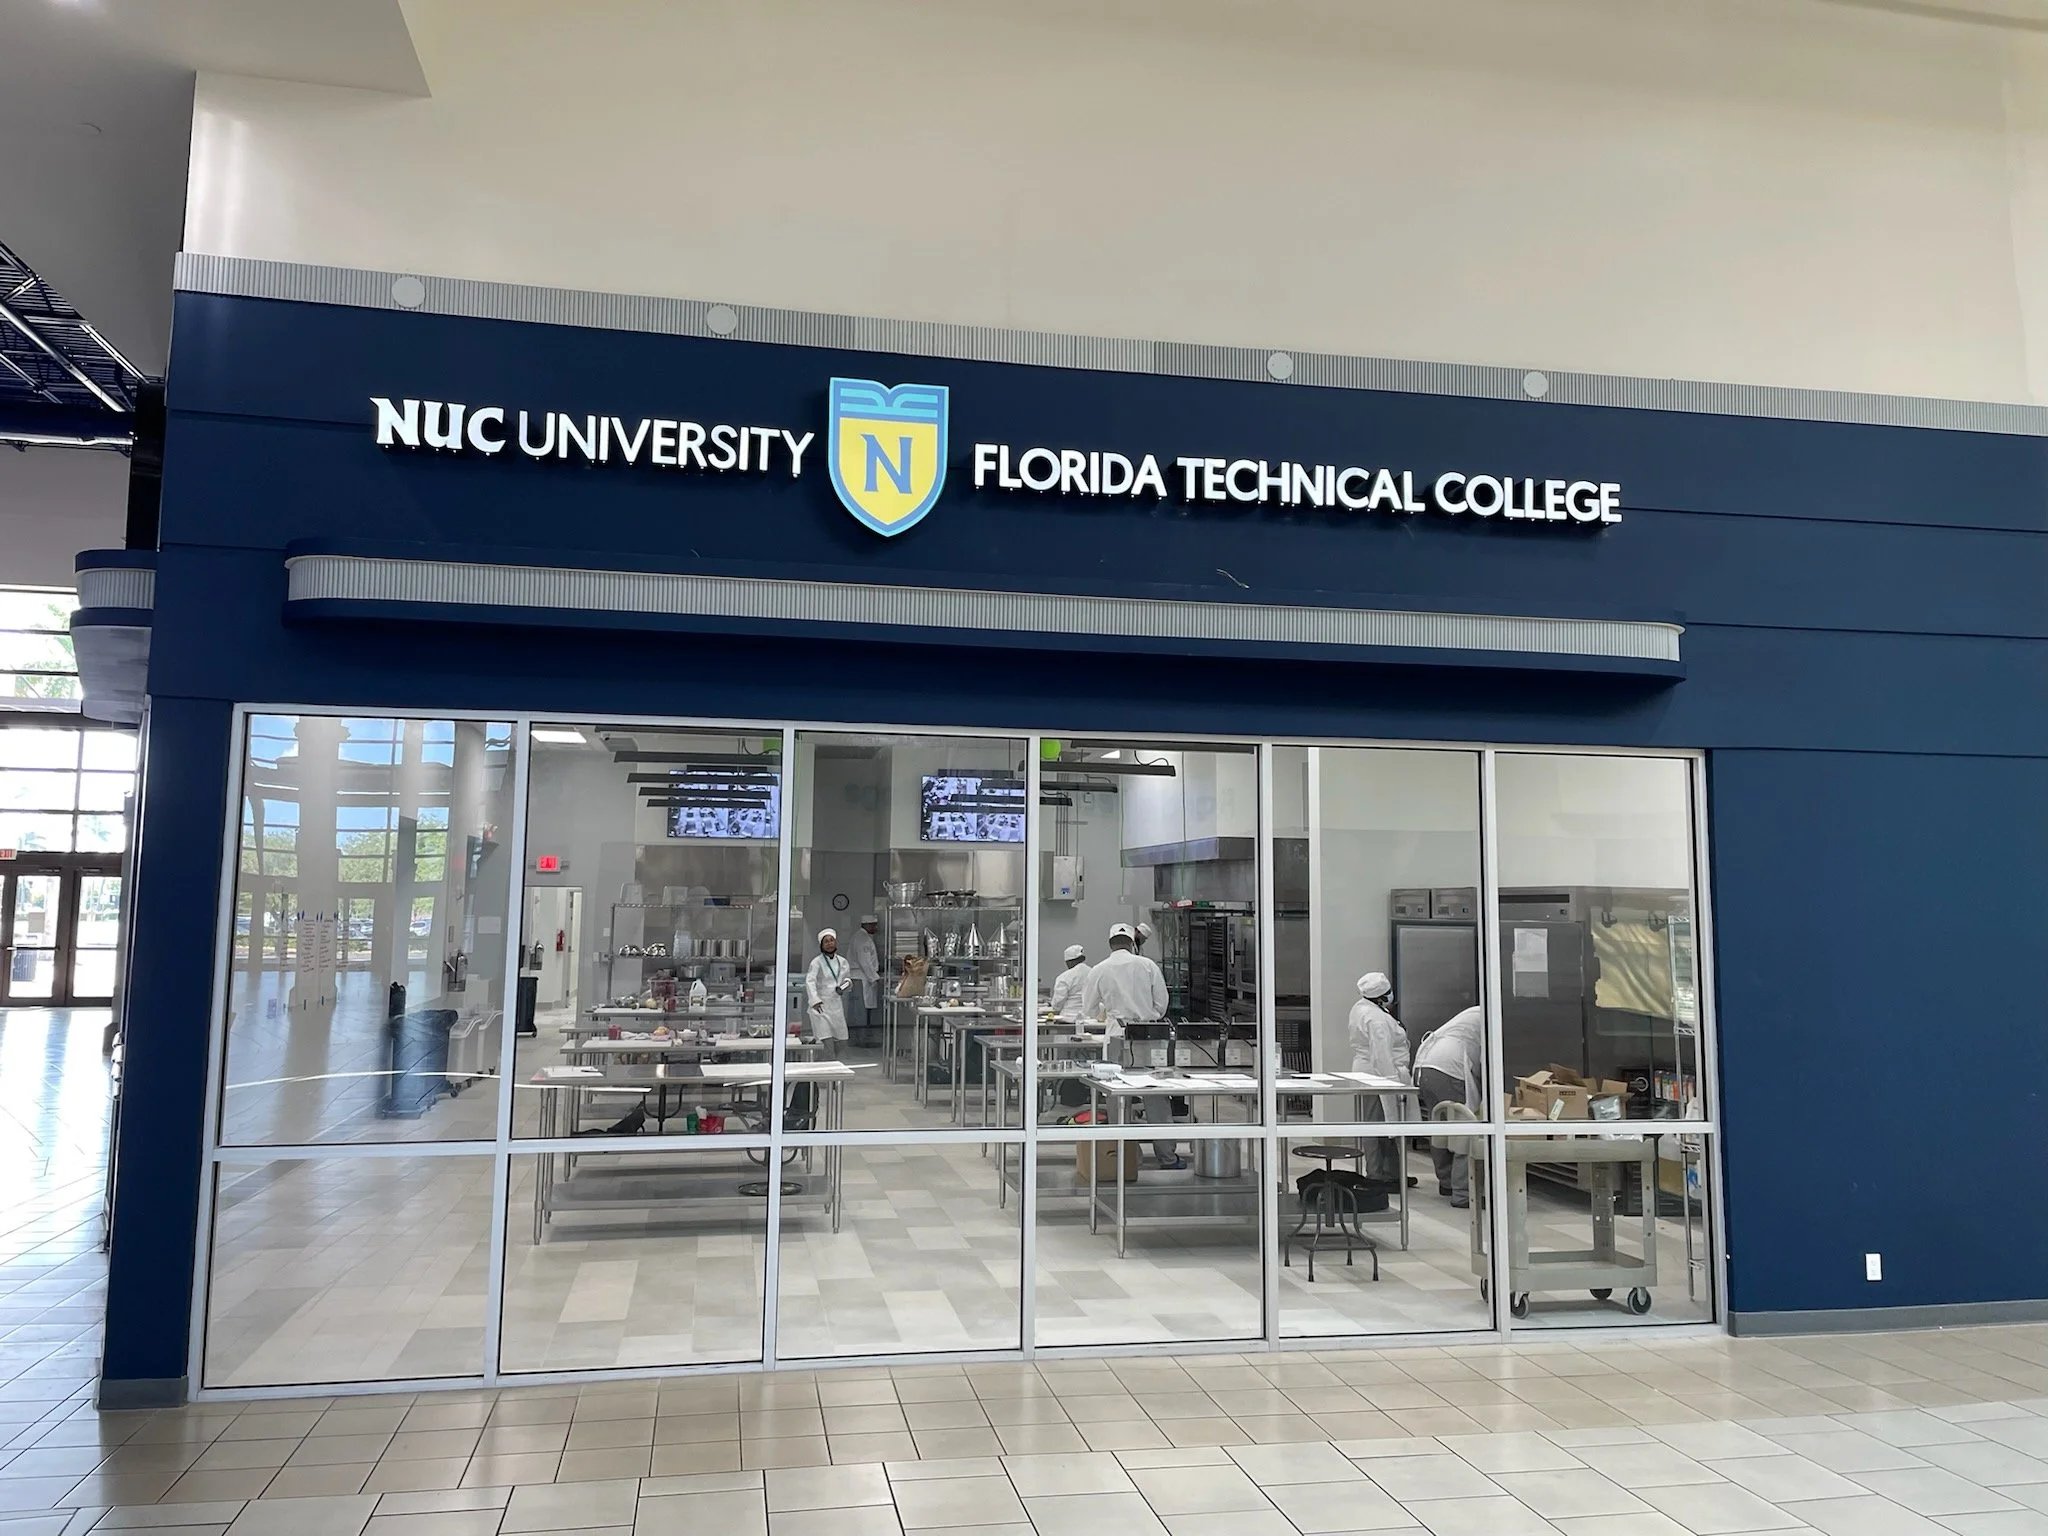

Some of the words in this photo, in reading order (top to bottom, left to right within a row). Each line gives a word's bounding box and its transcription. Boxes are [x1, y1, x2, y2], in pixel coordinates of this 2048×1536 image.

[369, 397, 506, 455] NUC
[518, 410, 815, 476] UNIVERSITY
[859, 432, 913, 494] N
[974, 443, 1168, 499] FLORIDA
[1176, 456, 1426, 513] TECHNICAL
[1434, 471, 1623, 523] COLLEGE
